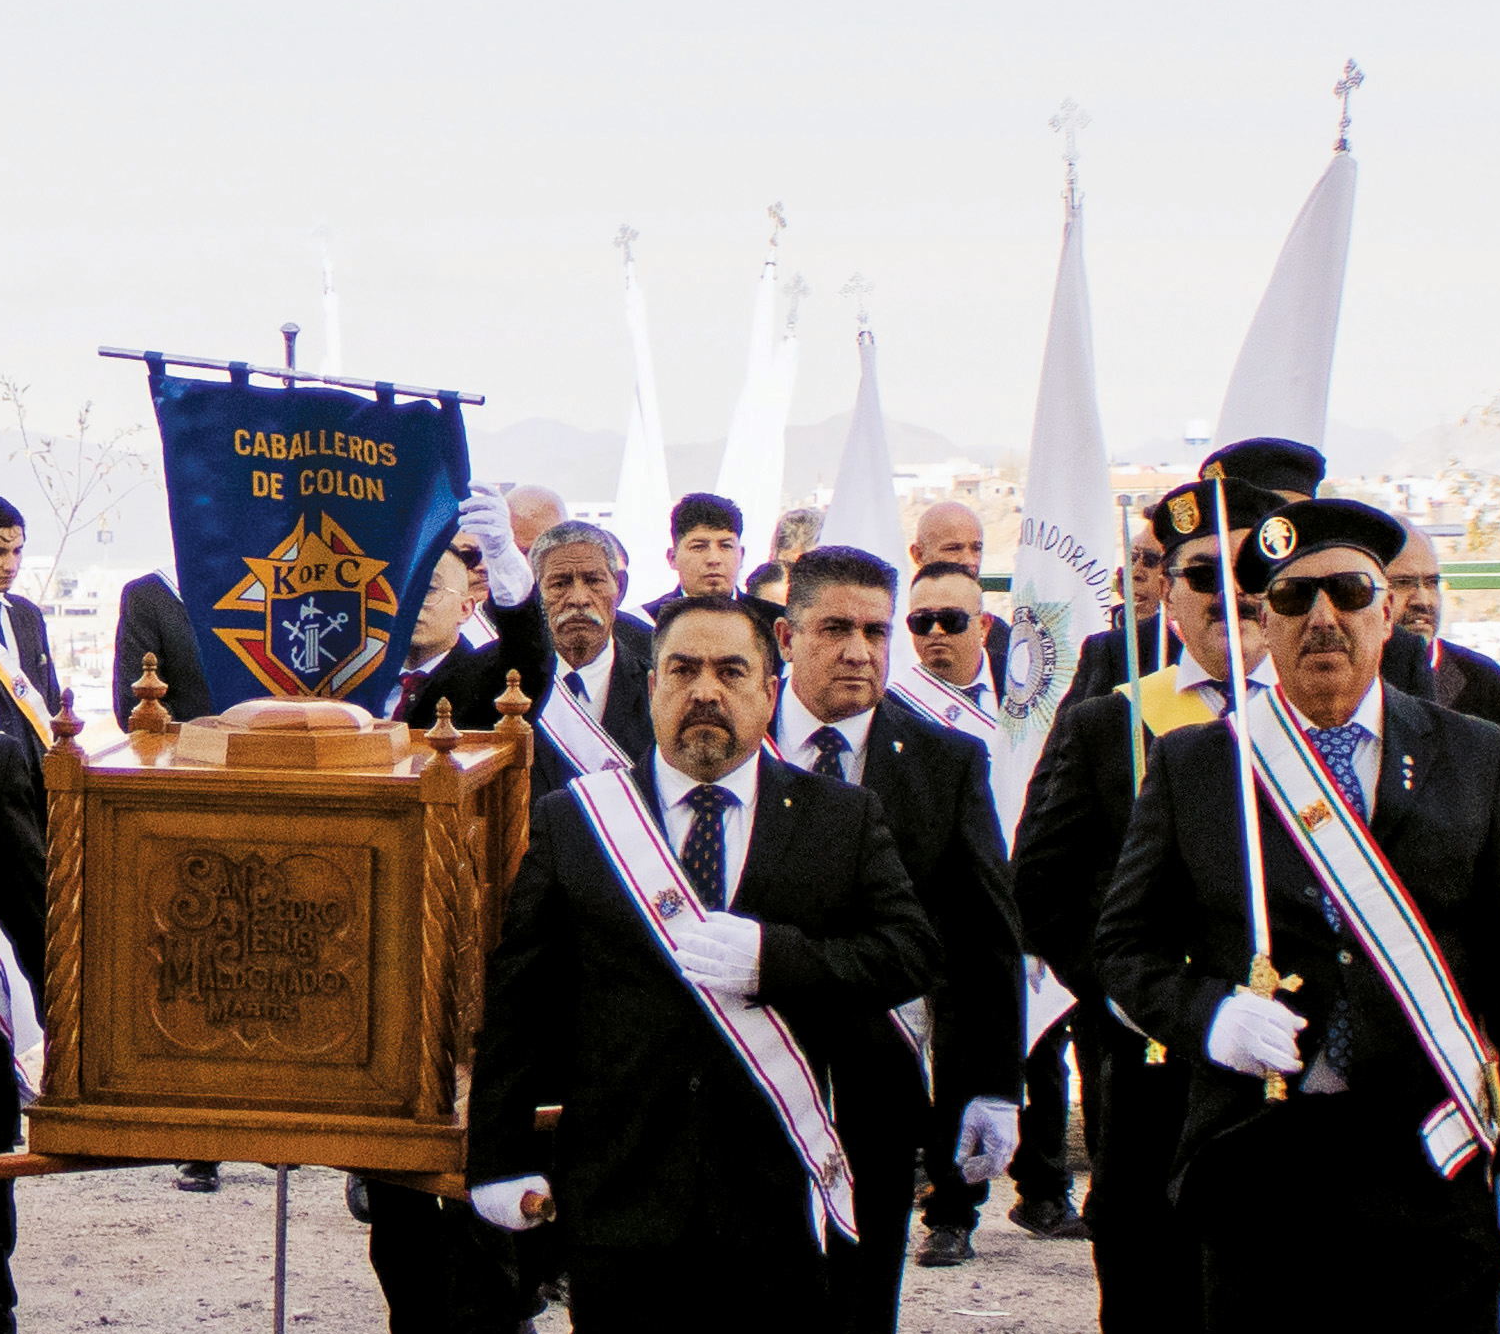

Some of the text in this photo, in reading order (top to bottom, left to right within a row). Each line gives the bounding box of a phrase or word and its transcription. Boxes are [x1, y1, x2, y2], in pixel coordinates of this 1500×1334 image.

[234, 429, 397, 467] CABALLEROS
[252, 469, 386, 502] DE COLON
[272, 558, 361, 594] K OF C
